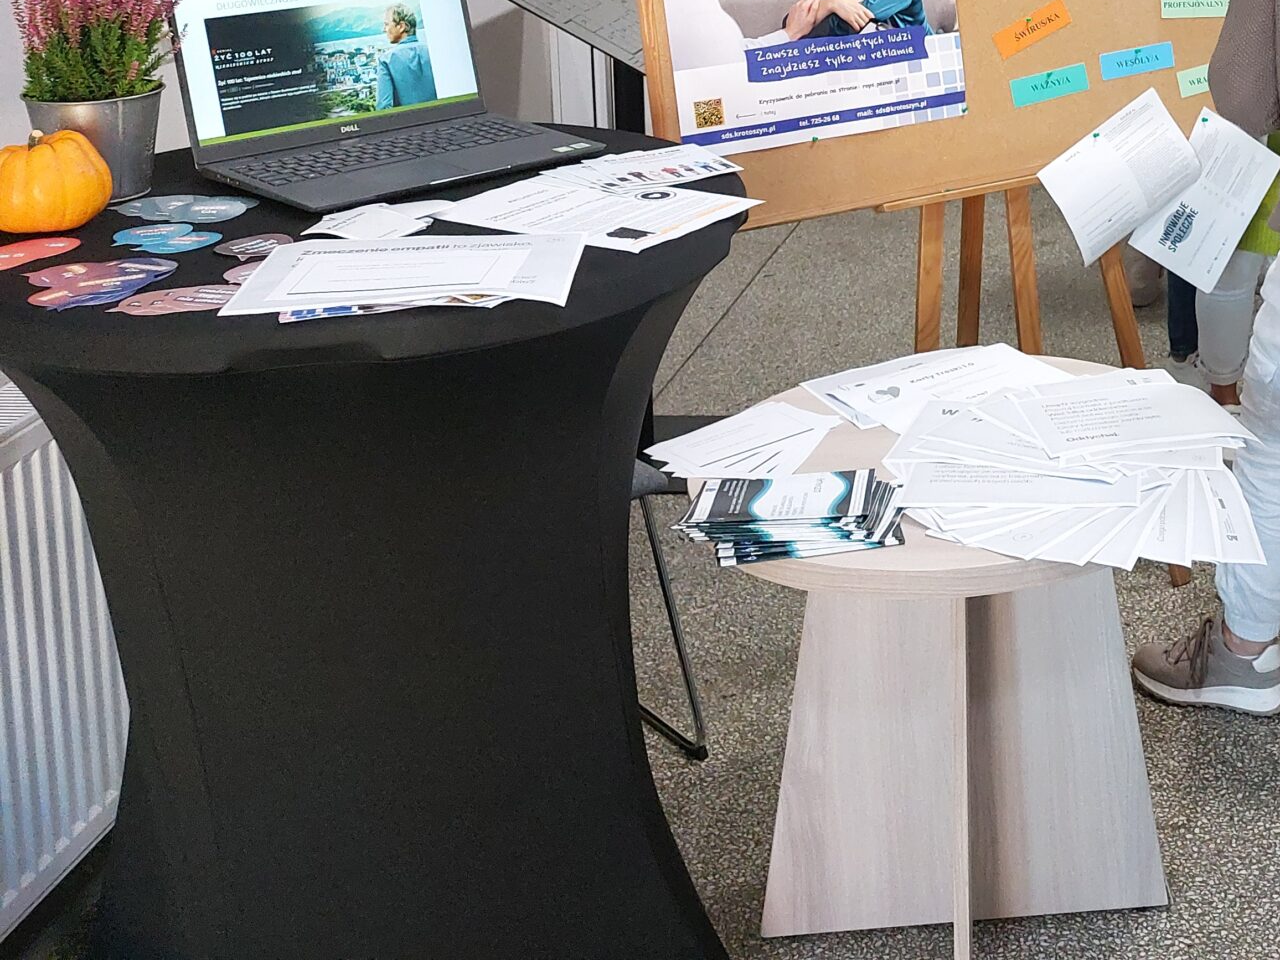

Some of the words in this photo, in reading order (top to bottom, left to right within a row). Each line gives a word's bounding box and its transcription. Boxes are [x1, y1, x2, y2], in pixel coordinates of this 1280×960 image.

[1014, 11, 1062, 43] ŚWIRUS/KA
[234, 50, 253, 58] 100
[255, 48, 272, 56] LAT
[755, 48, 800, 61] Zawsze
[804, 36, 884, 55] uśmiechniętych
[888, 31, 912, 42] ludzi
[760, 58, 820, 78] znajdziesz
[824, 53, 853, 68] tylko
[870, 45, 914, 60] reklamie
[1030, 75, 1071, 94] WAŻNY/A
[341, 123, 360, 133] DELL
[721, 124, 776, 140] sds.krotoszyn.pl
[799, 120, 810, 128] tel.
[1158, 201, 1190, 247] INNOWACJE
[1168, 207, 1199, 253] SPOŁECZNE
